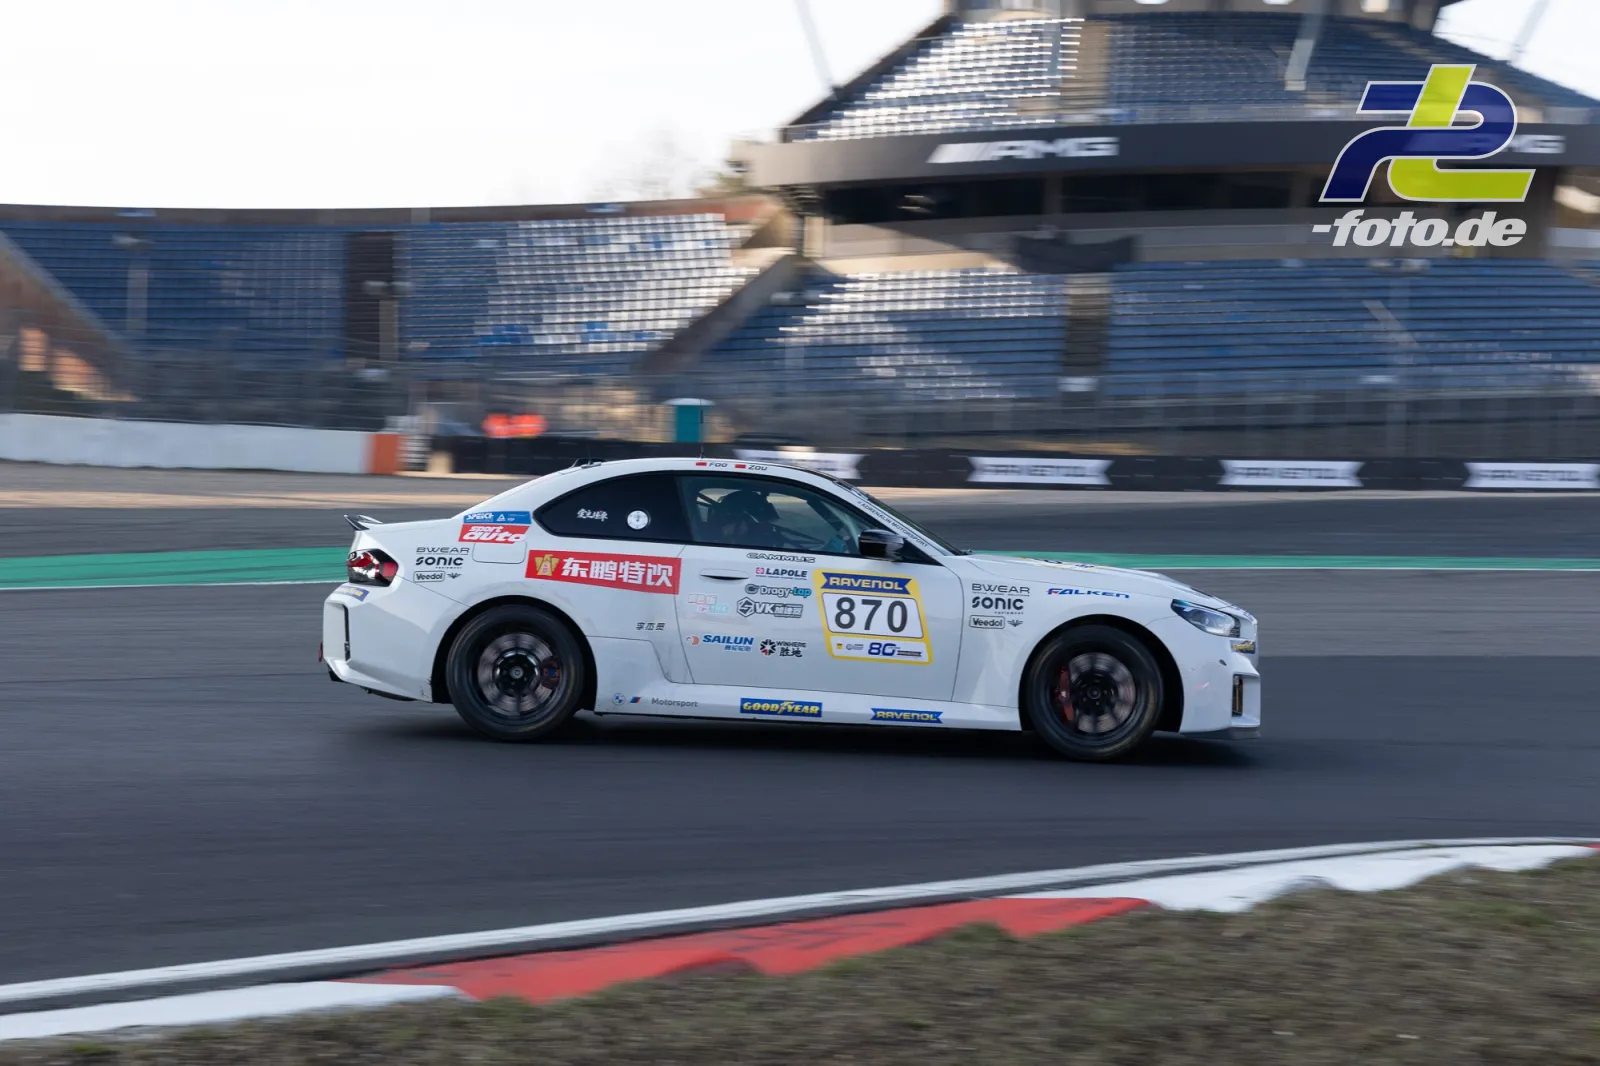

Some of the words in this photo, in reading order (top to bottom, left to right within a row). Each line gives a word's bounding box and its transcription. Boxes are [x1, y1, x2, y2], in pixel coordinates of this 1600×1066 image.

[982, 137, 1120, 161] AMG
[462, 531, 526, 542] auto
[746, 552, 816, 563] CAMMUS
[561, 557, 673, 587] 东鹏特饮
[765, 567, 808, 578] LAPOLE
[829, 577, 904, 590] RAVENOL
[971, 583, 1030, 594] BWEAR
[1047, 588, 1130, 599] FALKEN
[835, 597, 908, 633] 870
[973, 617, 1003, 627] Veedol
[703, 634, 754, 645] SAILUN
[651, 697, 698, 708] Motorsport
[875, 710, 937, 721] RAVENOL
